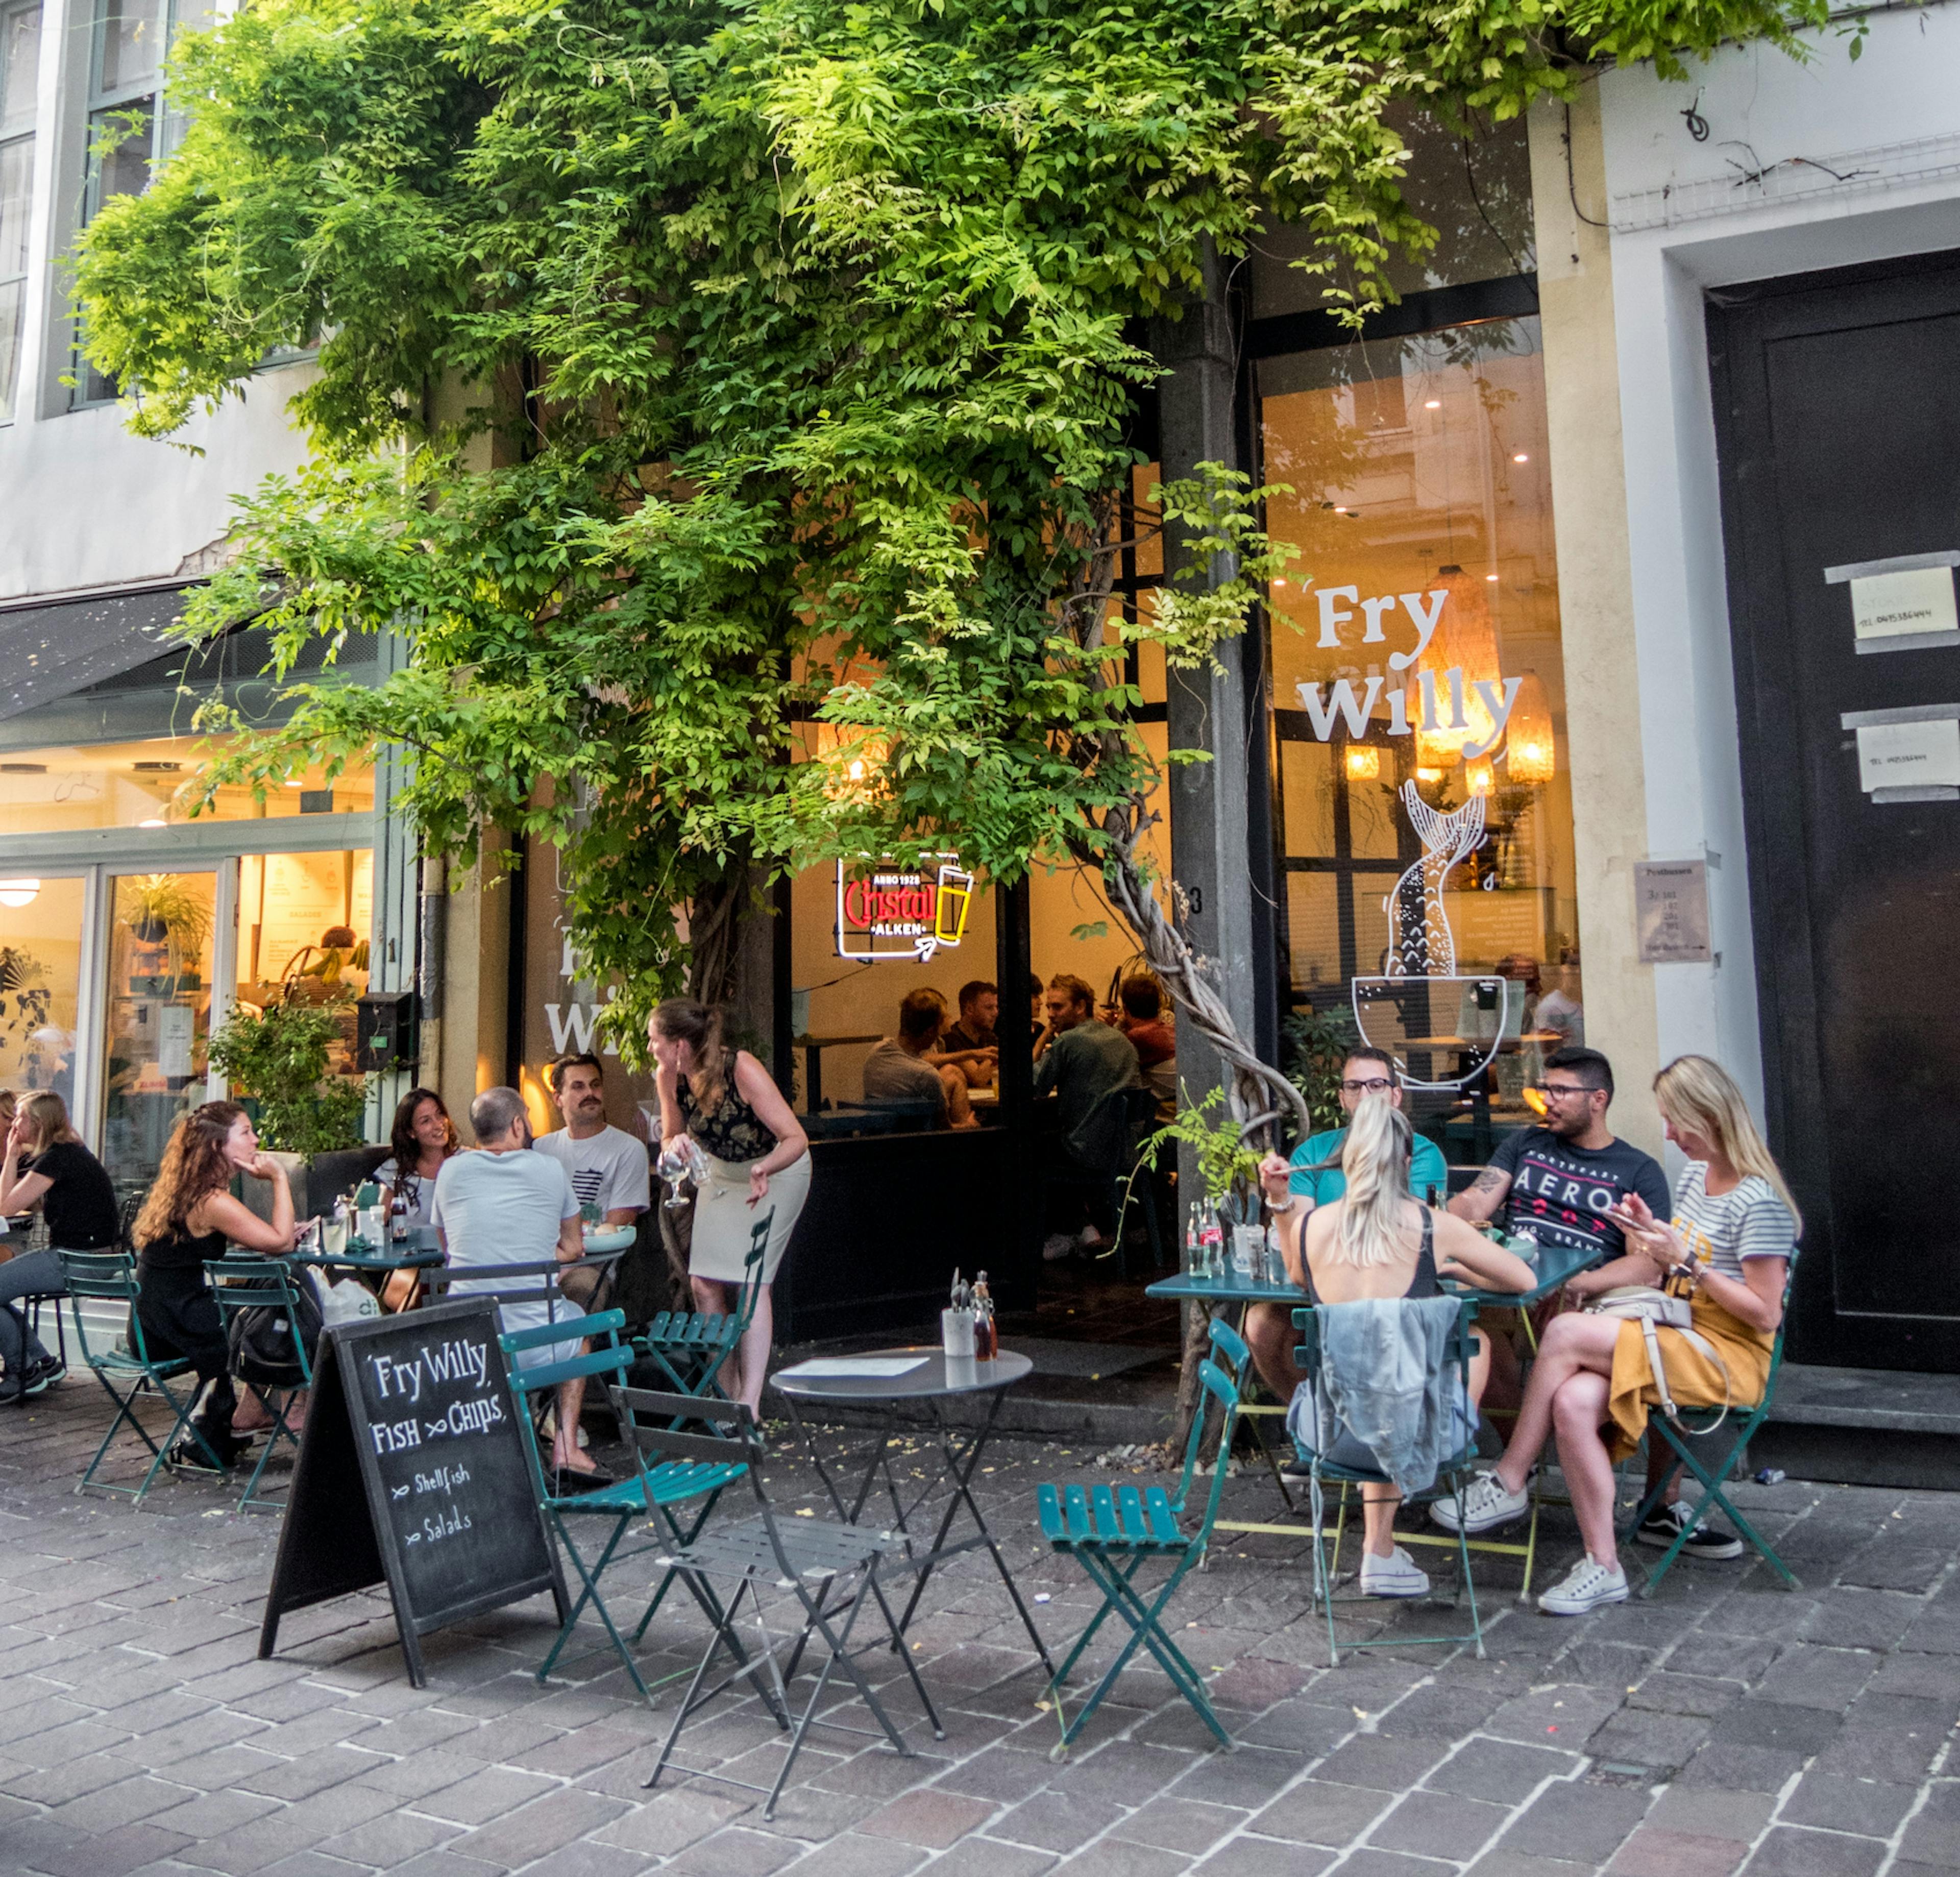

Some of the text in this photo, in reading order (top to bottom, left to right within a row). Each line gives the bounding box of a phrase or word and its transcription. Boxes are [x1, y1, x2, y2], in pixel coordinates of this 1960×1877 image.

[873, 874, 921, 885] ANNO 1928
[845, 880, 936, 928] Cristal
[1190, 887, 1202, 914] 3
[875, 923, 922, 936] ALKEN
[1528, 1150, 1620, 1181] NORTHEAST
[1514, 1166, 1612, 1212] AERO
[415, 1463, 470, 1495] Shellfish
[424, 1505, 472, 1542] Salads
